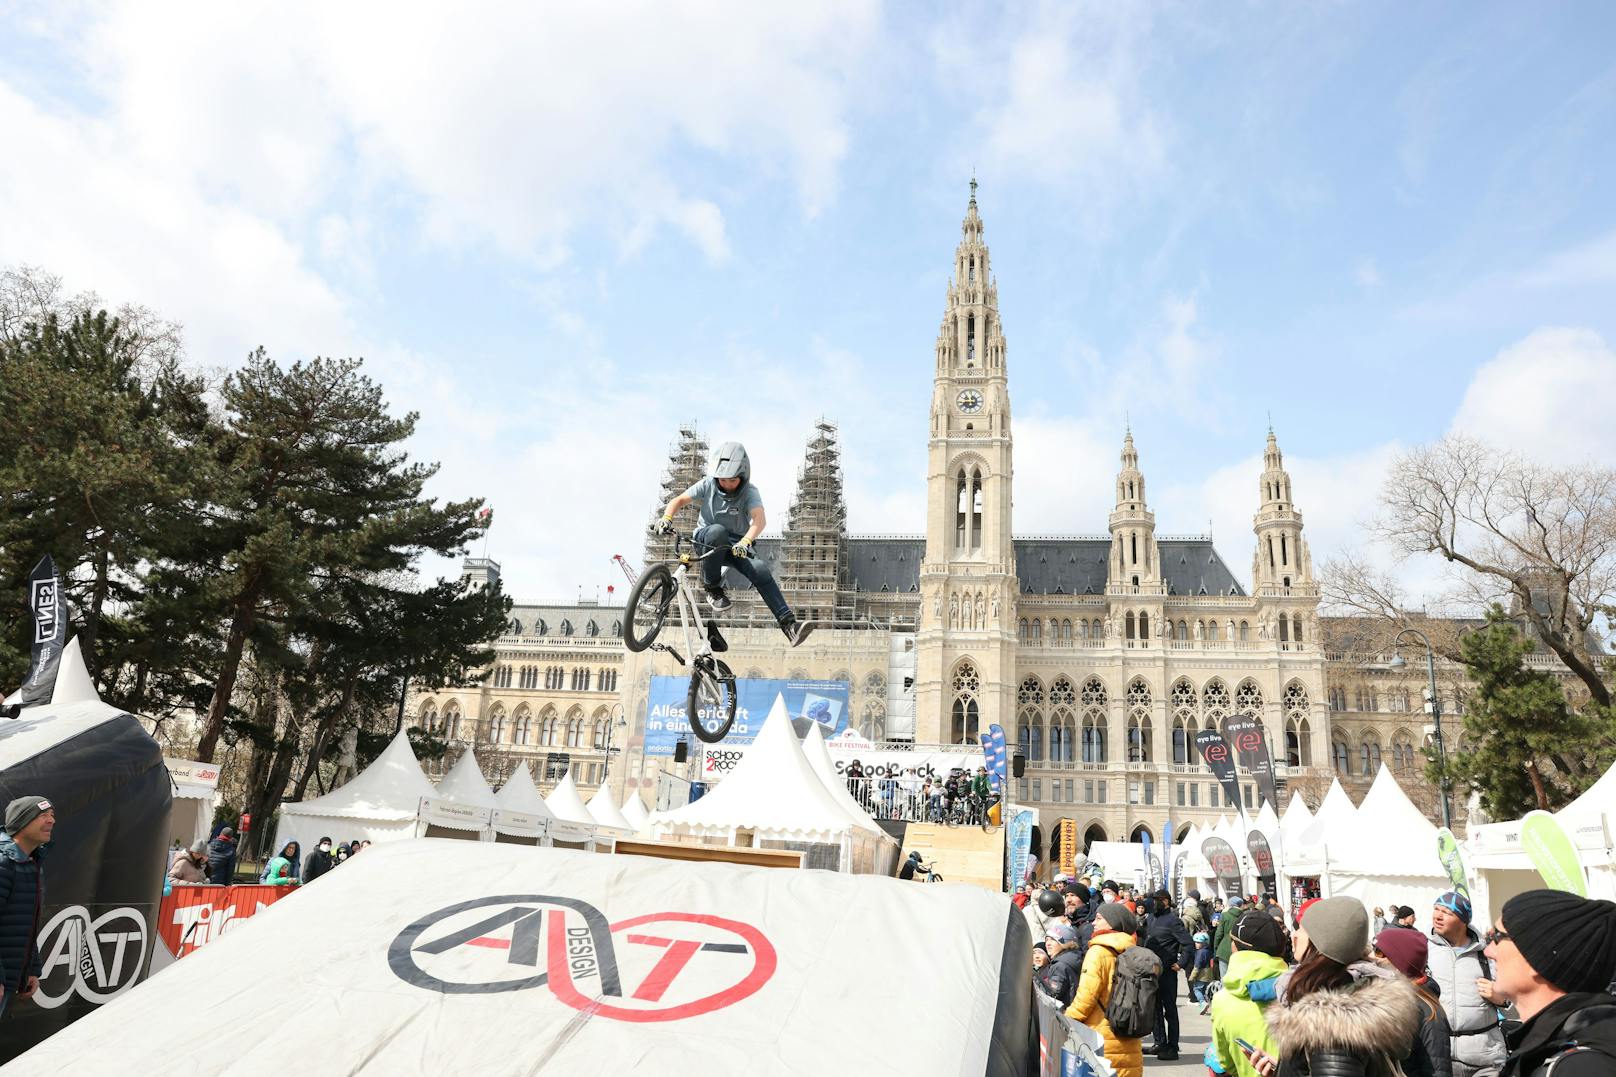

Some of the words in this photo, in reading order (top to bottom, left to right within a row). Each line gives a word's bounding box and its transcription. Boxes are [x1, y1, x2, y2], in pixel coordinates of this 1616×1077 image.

[651, 704, 685, 718] Alles
[696, 706, 748, 721] erläft
[650, 719, 663, 731] in
[706, 720, 748, 734] Oda
[844, 742, 871, 750] FESTIVAL
[1151, 857, 1161, 892] GARM
[566, 926, 598, 981] DESIGN
